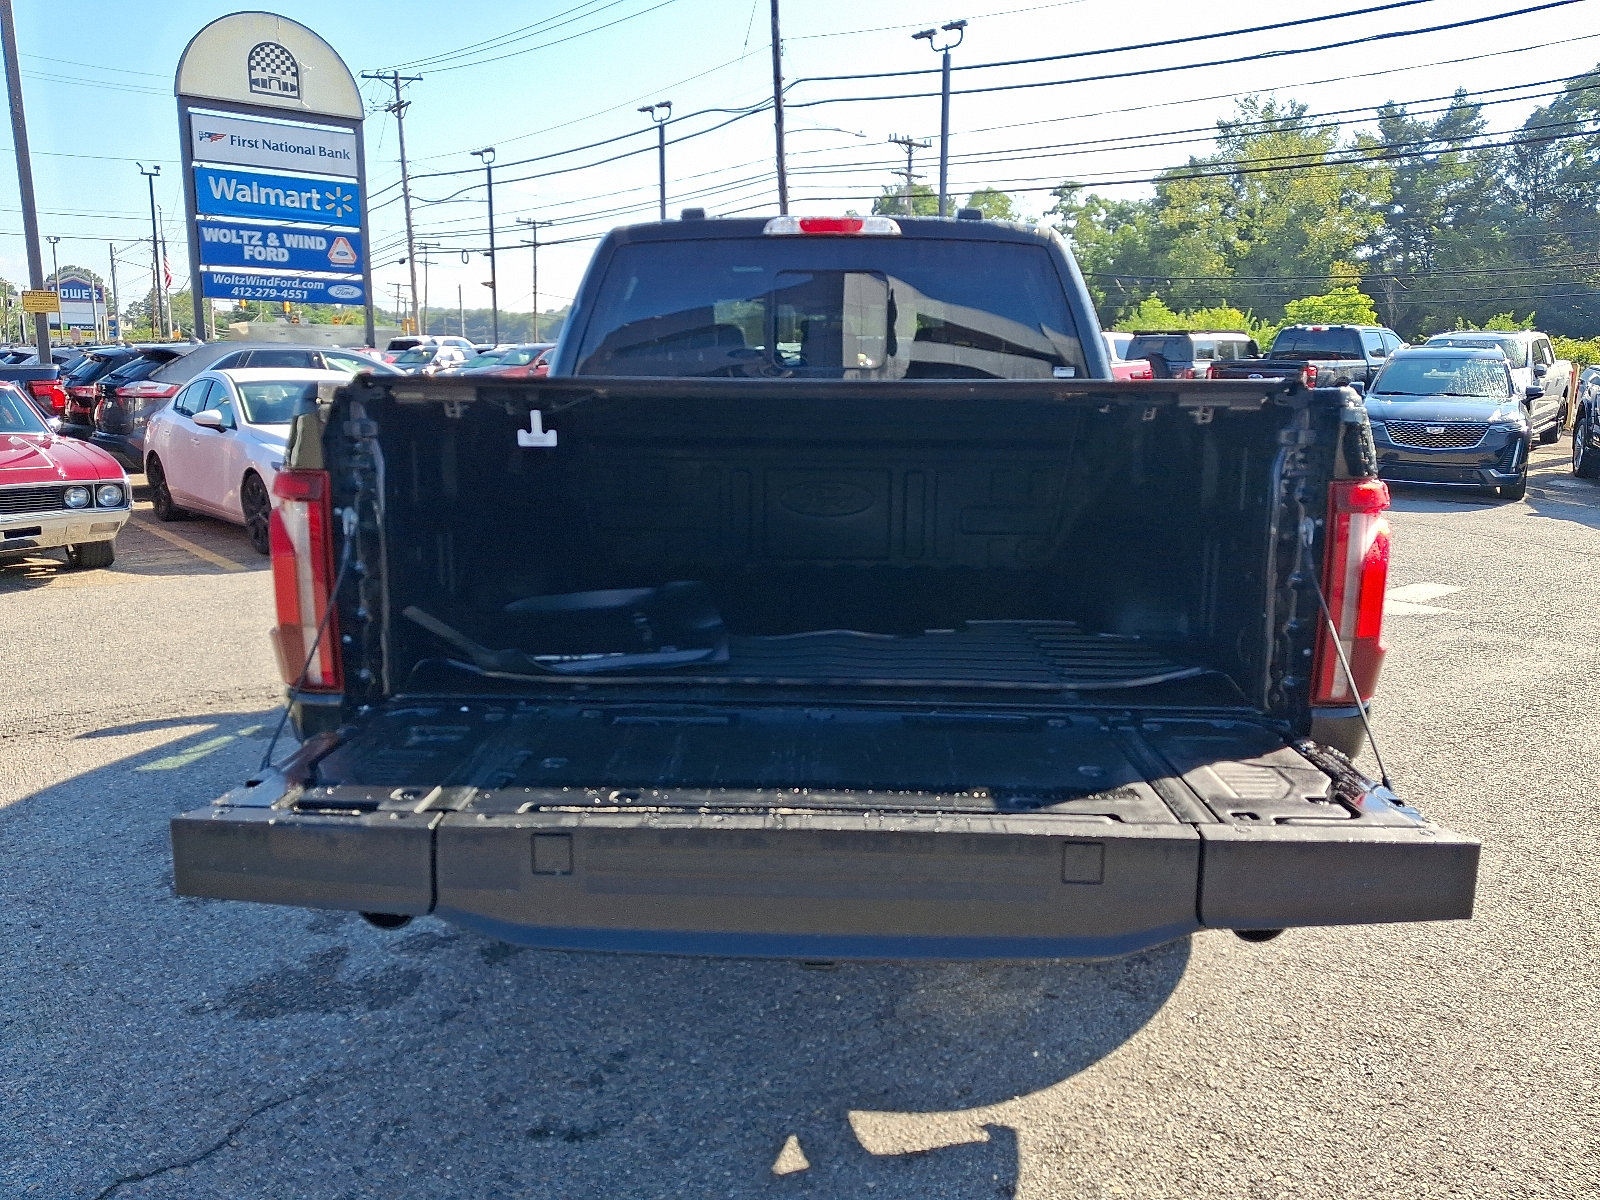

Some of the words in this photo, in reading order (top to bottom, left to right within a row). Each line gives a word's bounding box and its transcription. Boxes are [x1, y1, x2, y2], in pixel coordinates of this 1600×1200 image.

[230, 135, 259, 149] First
[262, 139, 316, 156] National
[319, 146, 350, 160] Bank
[208, 175, 321, 211] Walmart
[202, 227, 263, 245] WOLTZ
[267, 232, 280, 247] &
[283, 234, 327, 250] WIND
[244, 246, 289, 262] FORD
[213, 274, 325, 290] WoltzWindFord.com
[231, 286, 308, 299] 412-279-4551
